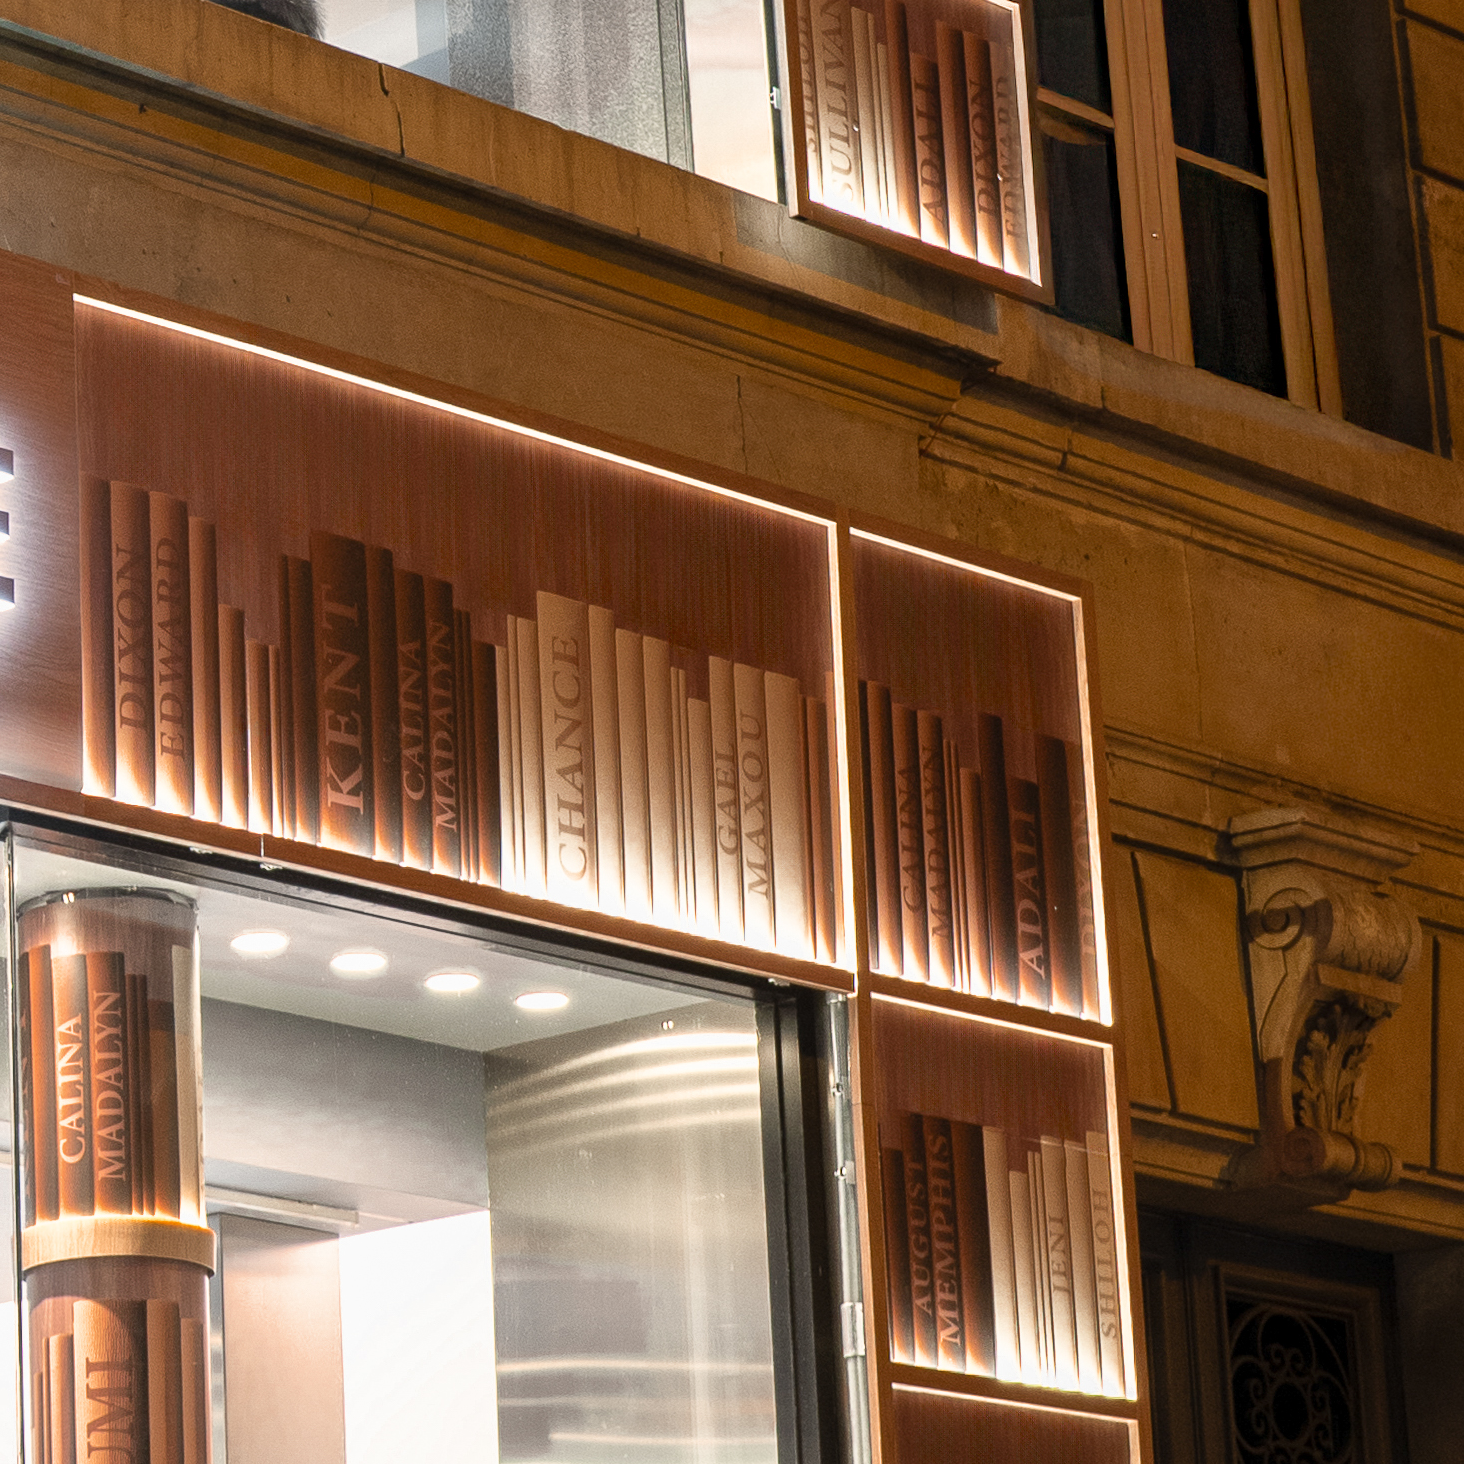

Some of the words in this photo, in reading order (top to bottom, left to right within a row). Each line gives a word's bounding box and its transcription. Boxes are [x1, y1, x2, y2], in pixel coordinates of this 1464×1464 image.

[913, 75, 943, 225] ADALI
[969, 77, 997, 216] DIXON
[115, 541, 149, 733] DIXON
[156, 536, 187, 761] EDWARD
[321, 583, 363, 815] KENT
[398, 636, 426, 801] CALINA
[429, 619, 458, 833] MADALYN
[551, 635, 587, 882] CHANCE
[716, 740, 739, 857] GAEL
[740, 708, 768, 899] MAXOU
[897, 762, 924, 914] CALINA
[921, 744, 948, 940] MADALYN
[1011, 806, 1045, 979] ADALI
[56, 1013, 85, 1165] CALINA
[92, 990, 127, 1182] MADALYN
[909, 1153, 932, 1318] AUGUST
[928, 1131, 961, 1346] MEMPHIS
[1049, 1210, 1070, 1297] JENI
[1093, 1187, 1117, 1339] SHILOH
